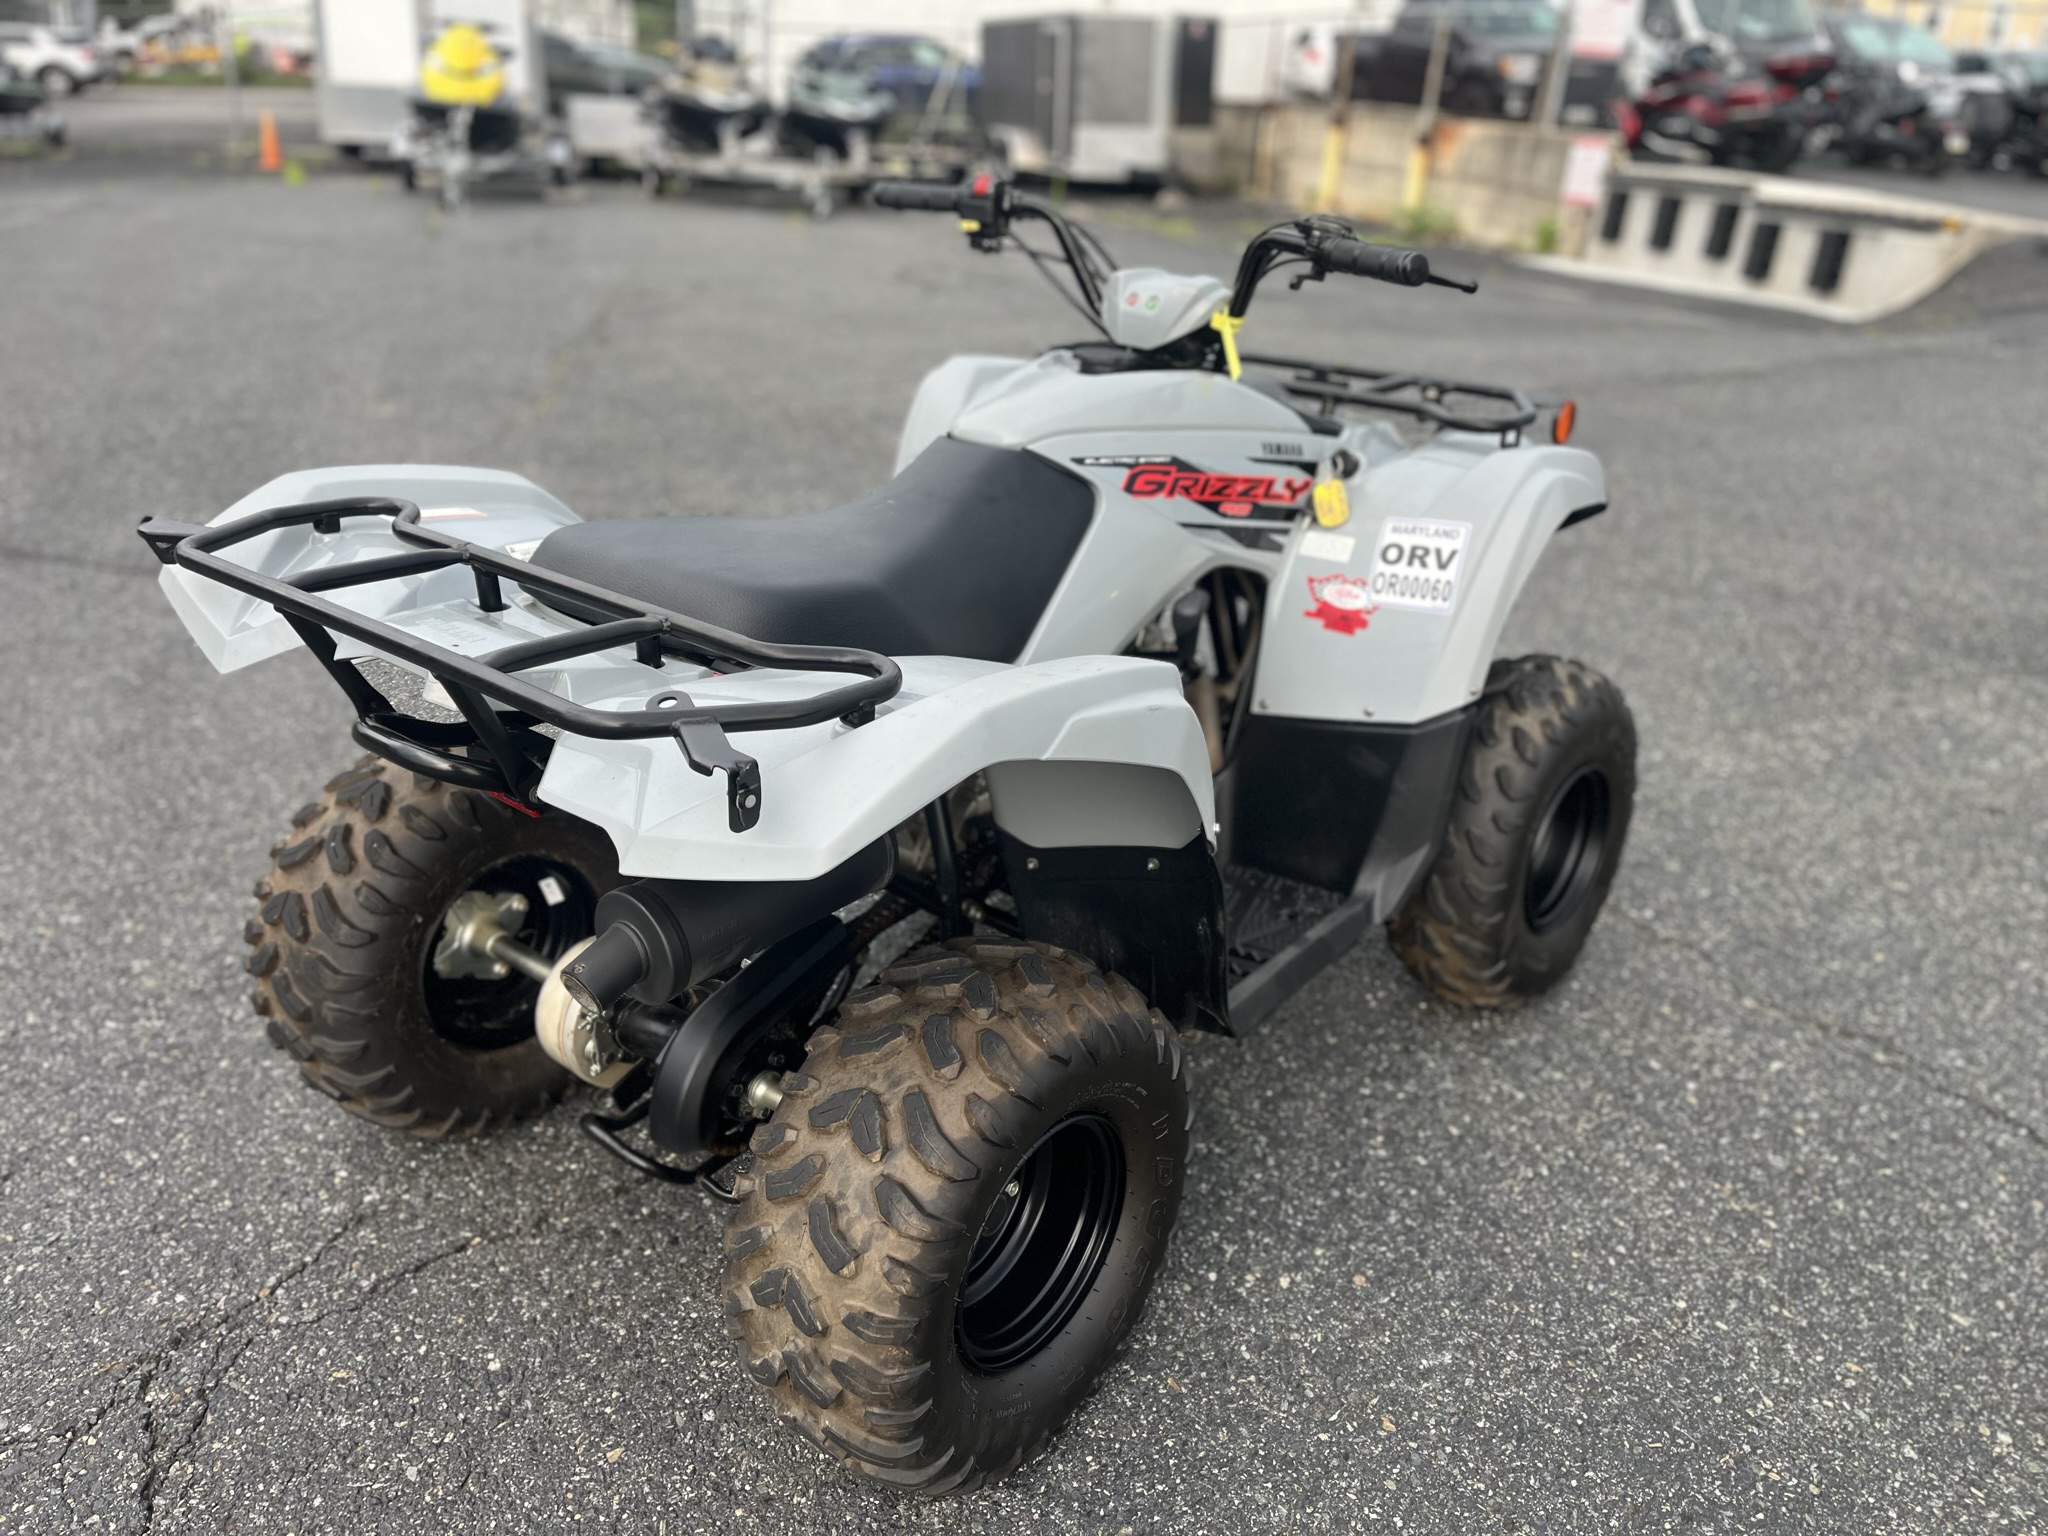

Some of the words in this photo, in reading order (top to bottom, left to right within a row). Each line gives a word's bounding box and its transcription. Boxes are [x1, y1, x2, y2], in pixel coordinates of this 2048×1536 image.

[1122, 465, 1314, 503] GRIZZLY
[1390, 524, 1461, 541] MARYLAND
[1380, 542, 1459, 571] ORV
[1371, 571, 1453, 603] OR00060
